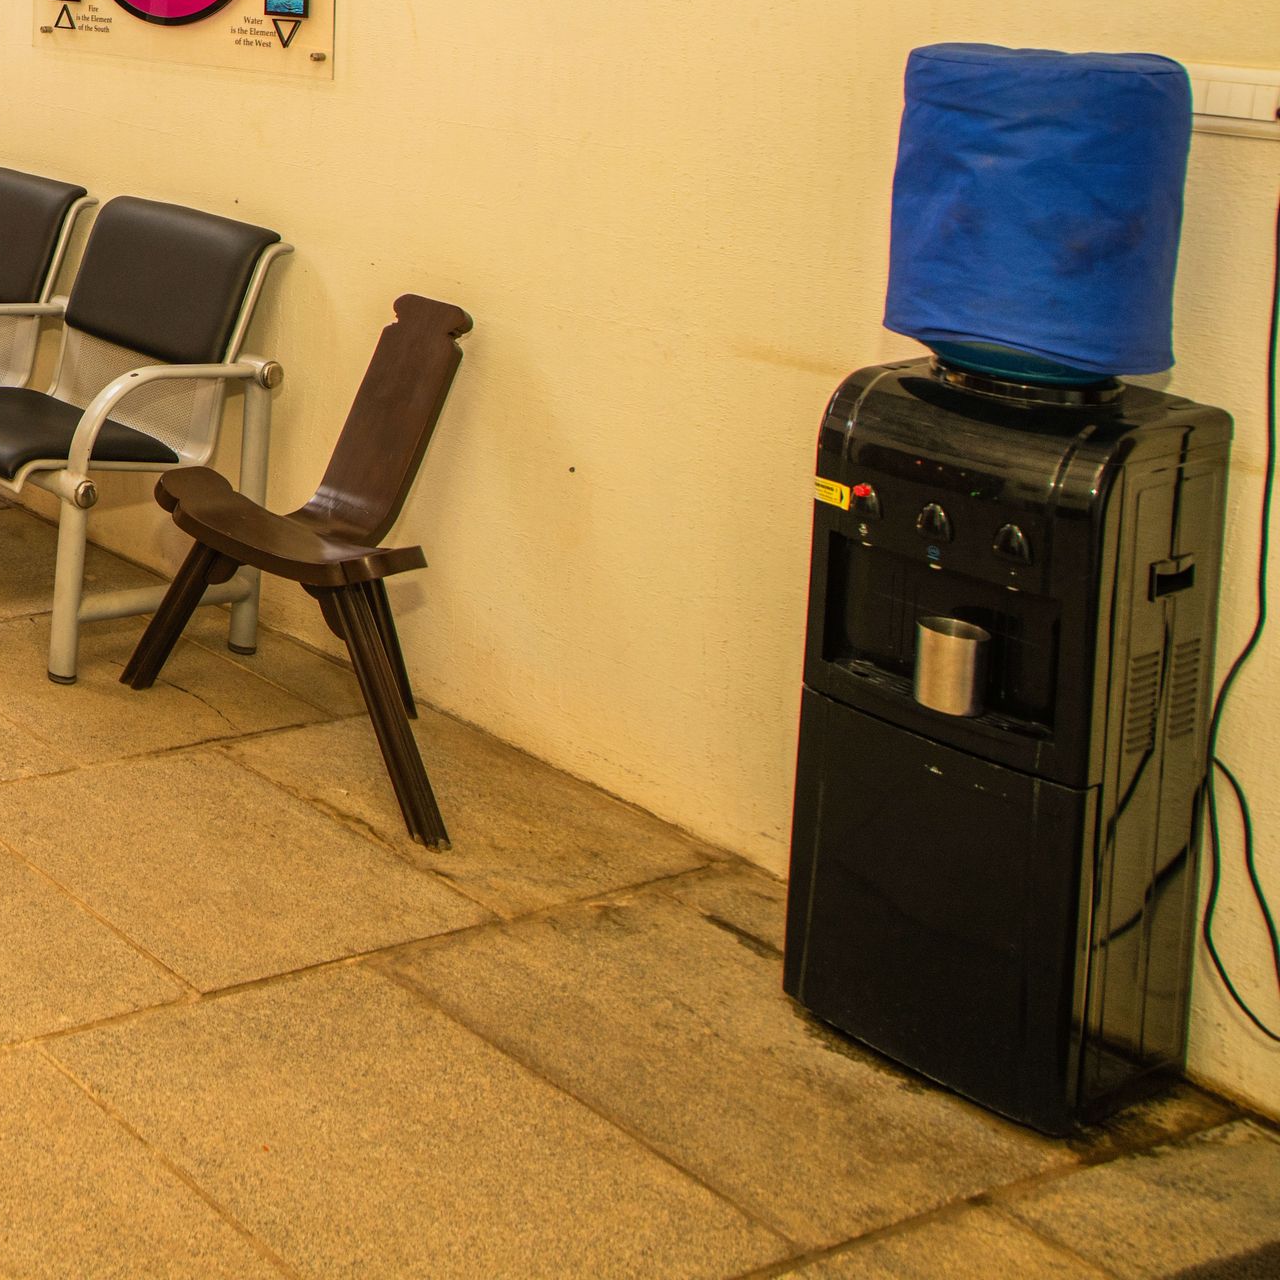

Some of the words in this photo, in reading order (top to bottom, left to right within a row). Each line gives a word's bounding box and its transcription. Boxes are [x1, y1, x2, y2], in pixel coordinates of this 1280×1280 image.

[88, 4, 99, 13] Fire
[76, 14, 81, 22] is
[81, 14, 90, 22] the
[91, 15, 112, 24] Element
[243, 16, 263, 25] Water
[78, 23, 84, 32] of
[85, 24, 93, 32] the
[94, 25, 110, 33] South
[230, 26, 236, 34] is
[237, 26, 248, 35] the
[250, 27, 277, 37] Element
[234, 37, 242, 46] of
[243, 38, 254, 47] the
[255, 39, 272, 48] West
